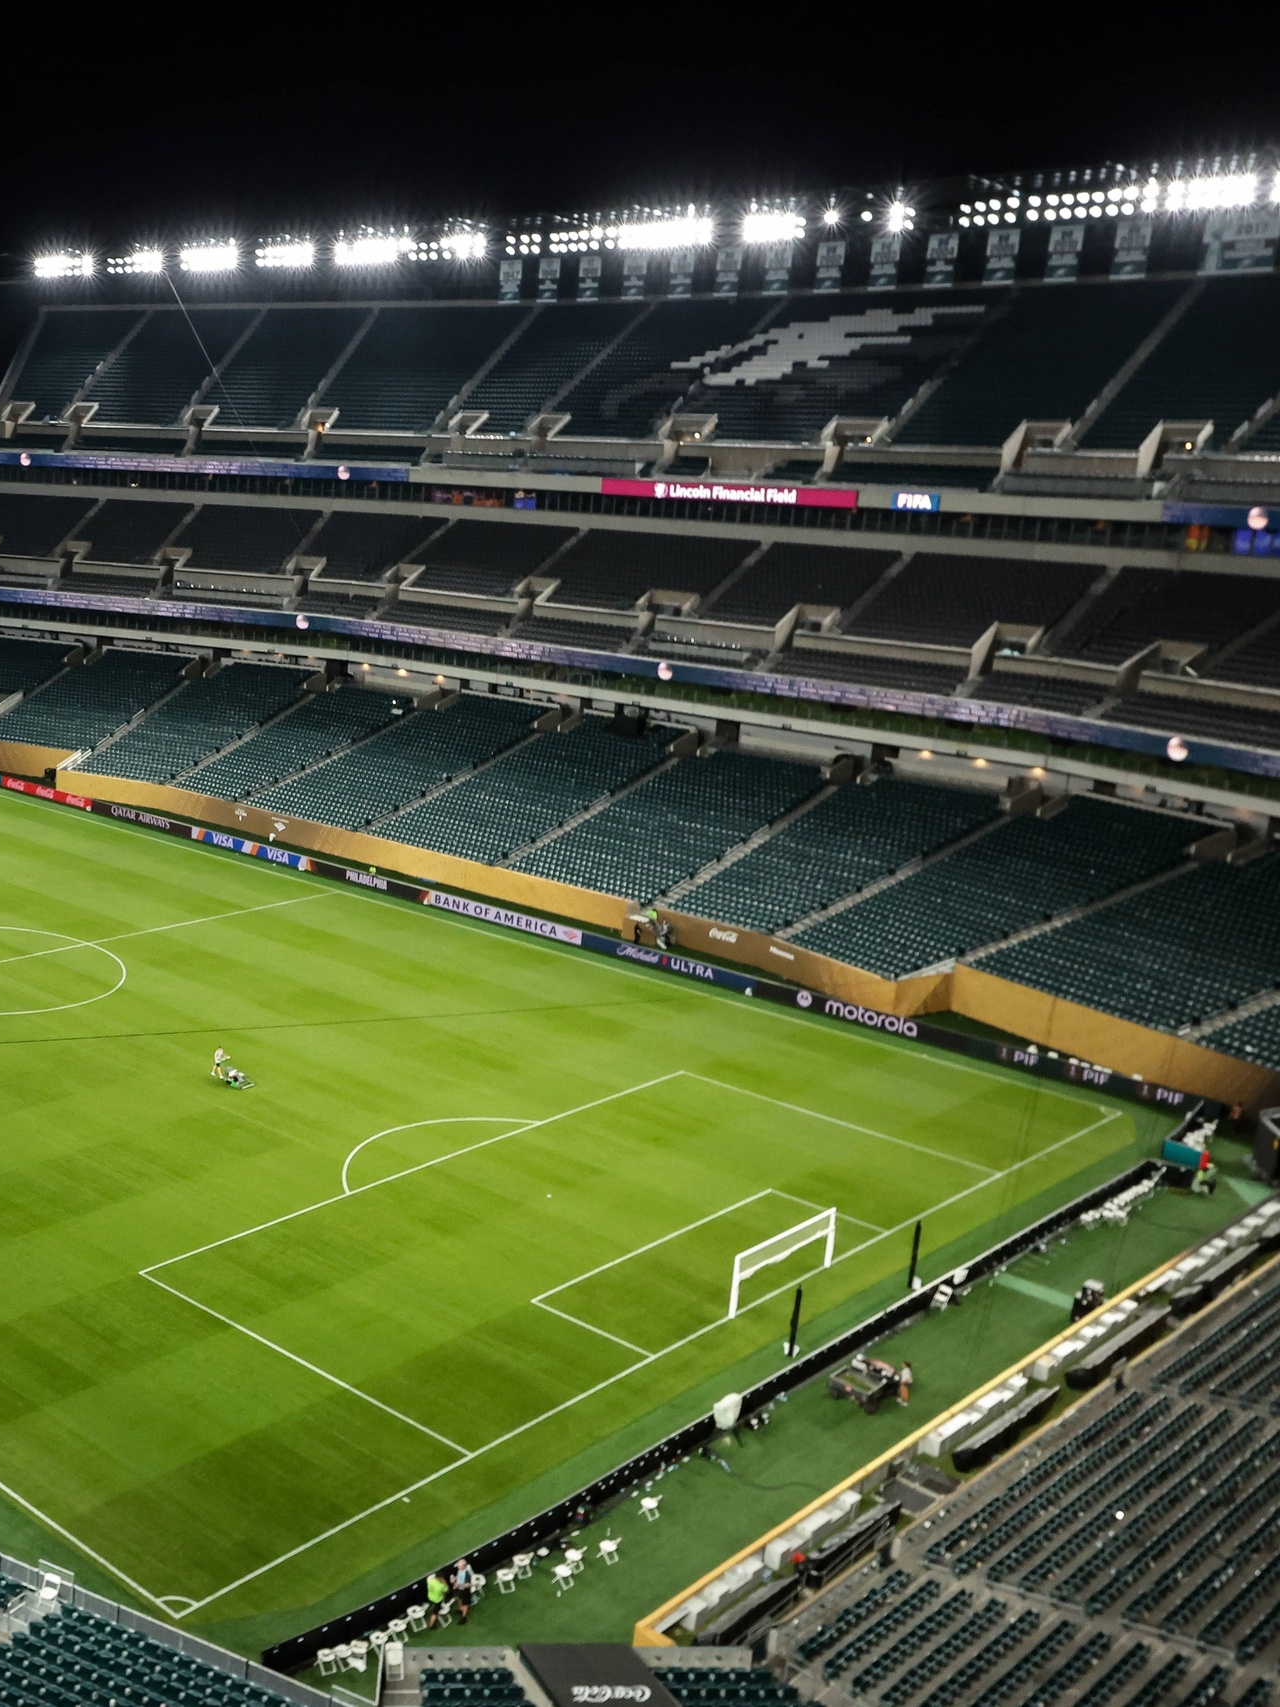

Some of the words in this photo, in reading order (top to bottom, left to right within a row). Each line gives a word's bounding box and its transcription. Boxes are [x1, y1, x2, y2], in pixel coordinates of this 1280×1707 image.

[670, 484, 710, 499] Lincoln
[712, 485, 764, 502] Financial
[766, 489, 797, 504] Field
[897, 493, 933, 510] FIFA
[110, 805, 136, 822] QATAR
[138, 811, 171, 830] AIRWAYS
[211, 833, 235, 850] VISA
[266, 847, 290, 865] VISA
[345, 869, 388, 891] PHILADELPHIA
[433, 893, 470, 915] BANK
[473, 904, 492, 919] OF
[493, 909, 558, 938] AMERICA
[670, 958, 714, 980] ULTRA
[825, 998, 919, 1038] motorola
[1013, 1049, 1039, 1067] PIF
[1082, 1066, 1110, 1087] PIF
[1155, 1087, 1185, 1105] PIF
